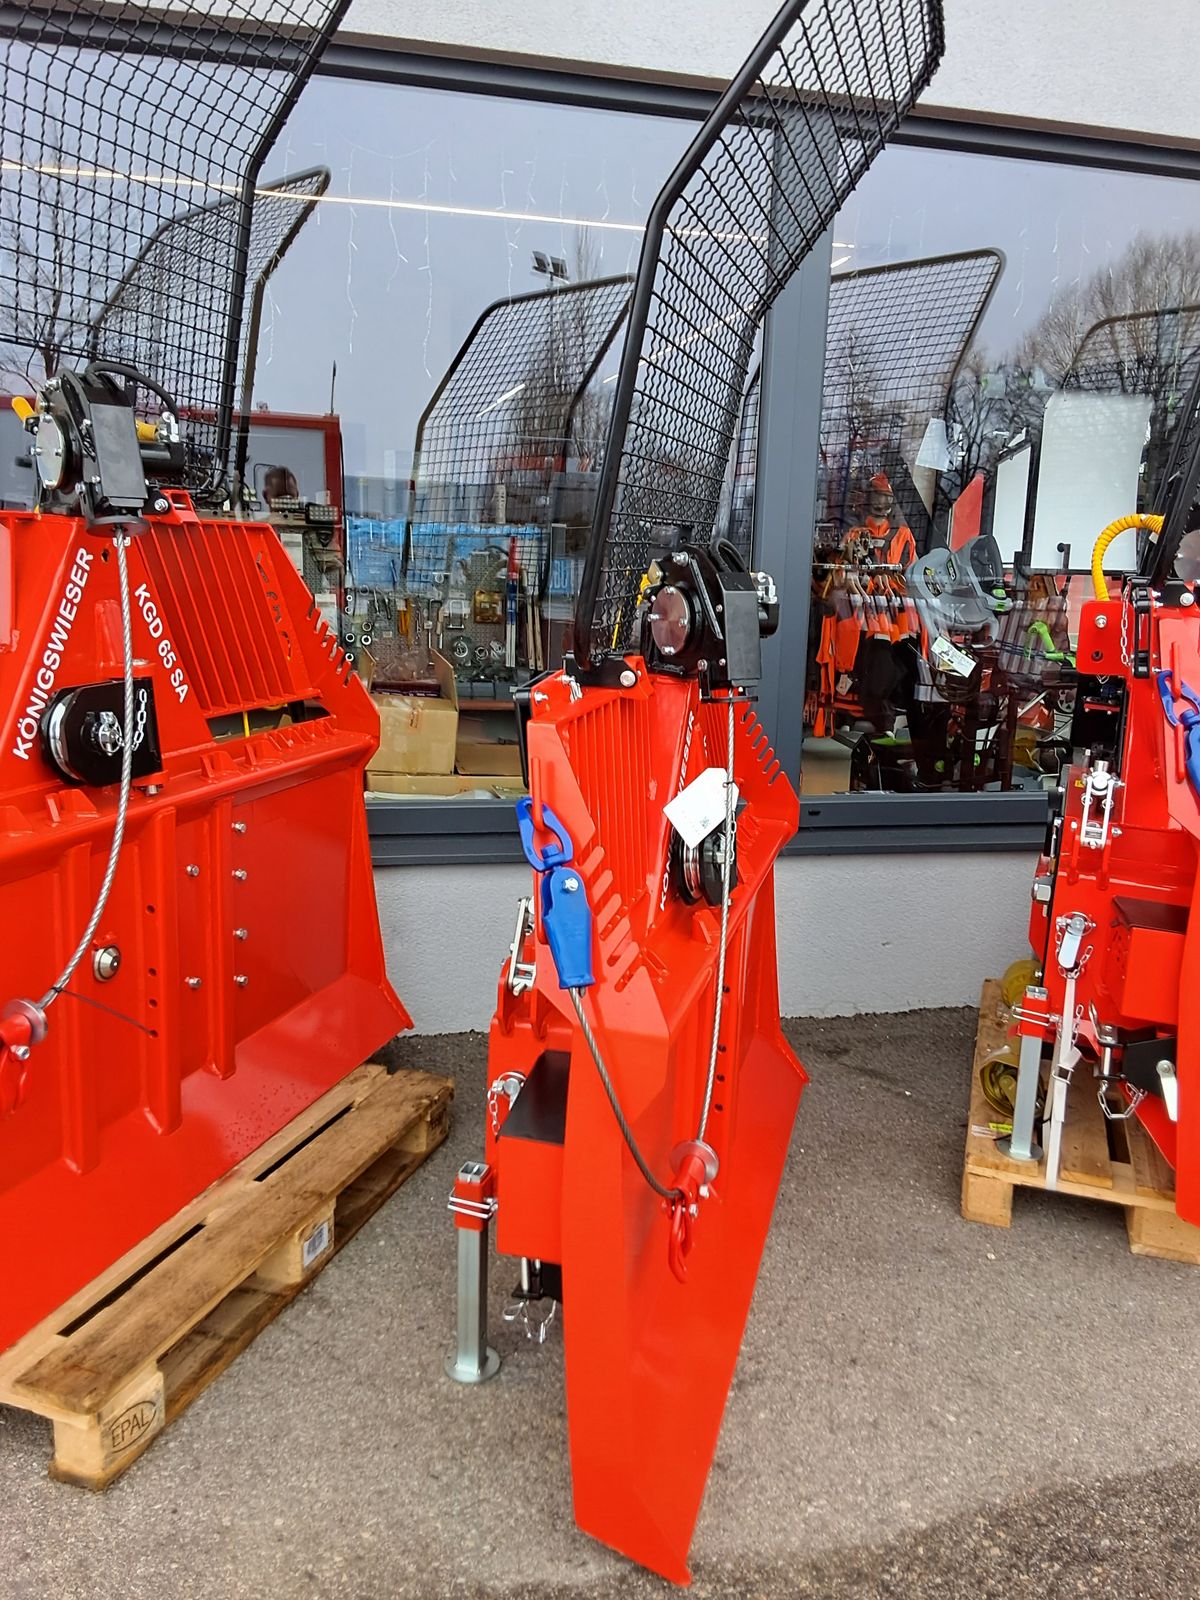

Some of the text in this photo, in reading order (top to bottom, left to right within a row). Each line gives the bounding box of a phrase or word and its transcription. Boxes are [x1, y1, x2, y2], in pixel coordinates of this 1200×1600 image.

[13, 547, 93, 760] KÖNIGSWIESER
[135, 583, 189, 703] KGD 65 SA
[111, 1408, 149, 1448] EPAL
